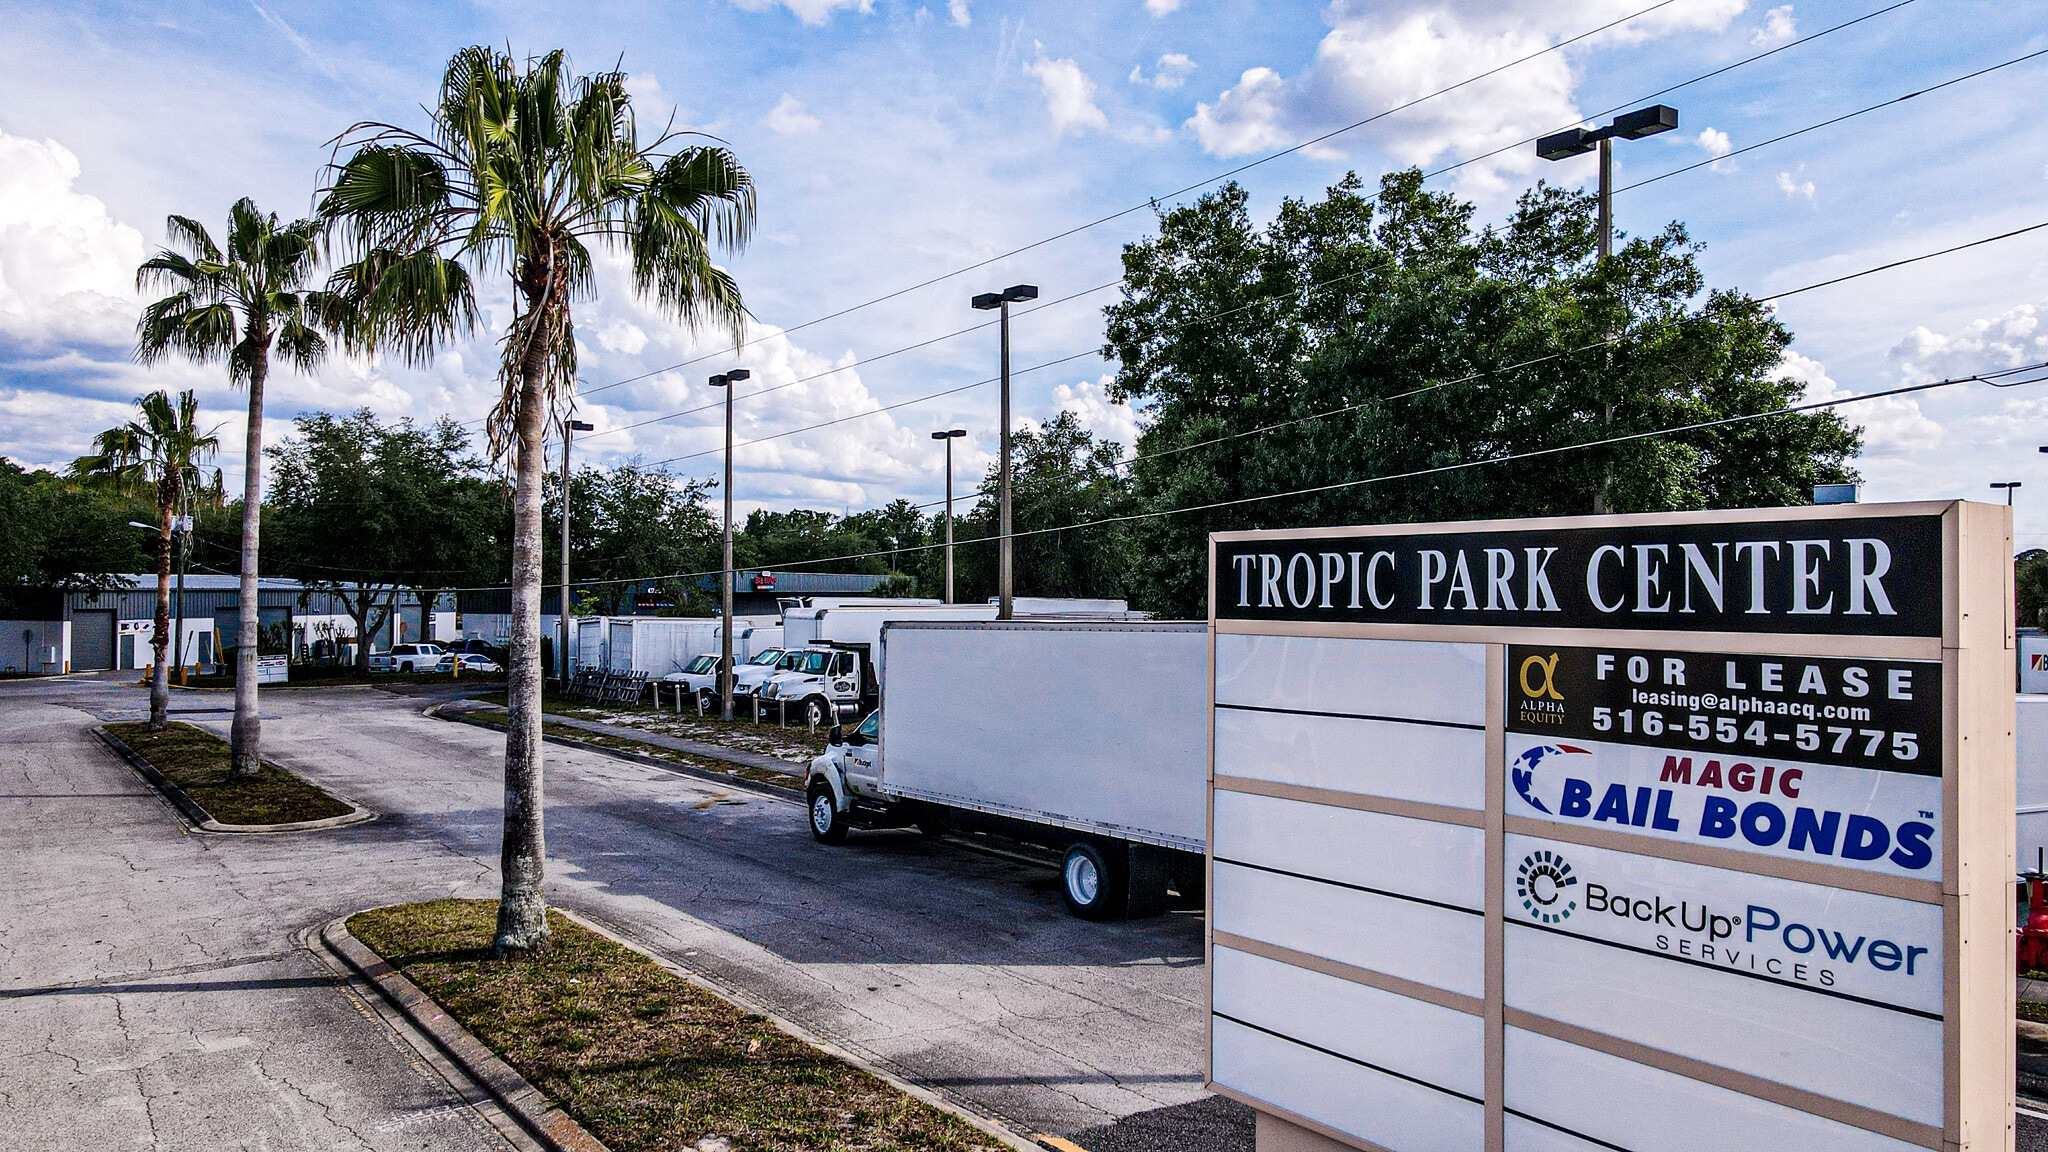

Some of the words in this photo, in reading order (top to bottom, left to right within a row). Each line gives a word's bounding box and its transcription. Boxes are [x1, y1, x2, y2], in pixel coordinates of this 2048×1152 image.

[1232, 551, 1396, 610] TROPIC
[1416, 547, 1562, 612] PARK
[1586, 538, 1898, 616] CENTER
[1596, 654, 1686, 686] FOR
[1726, 660, 1914, 701] LEASE
[1520, 700, 1565, 713] ALPHA
[1520, 711, 1565, 725] EQUITY
[1632, 688, 1871, 723] leasing@alphaacq.com
[1592, 706, 1919, 761] 516-554-5775
[1660, 755, 1804, 799] MAGIC
[1559, 777, 1680, 833] BAIL
[1699, 794, 1936, 871] BONDS
[1655, 934, 1835, 987] SERVICES
